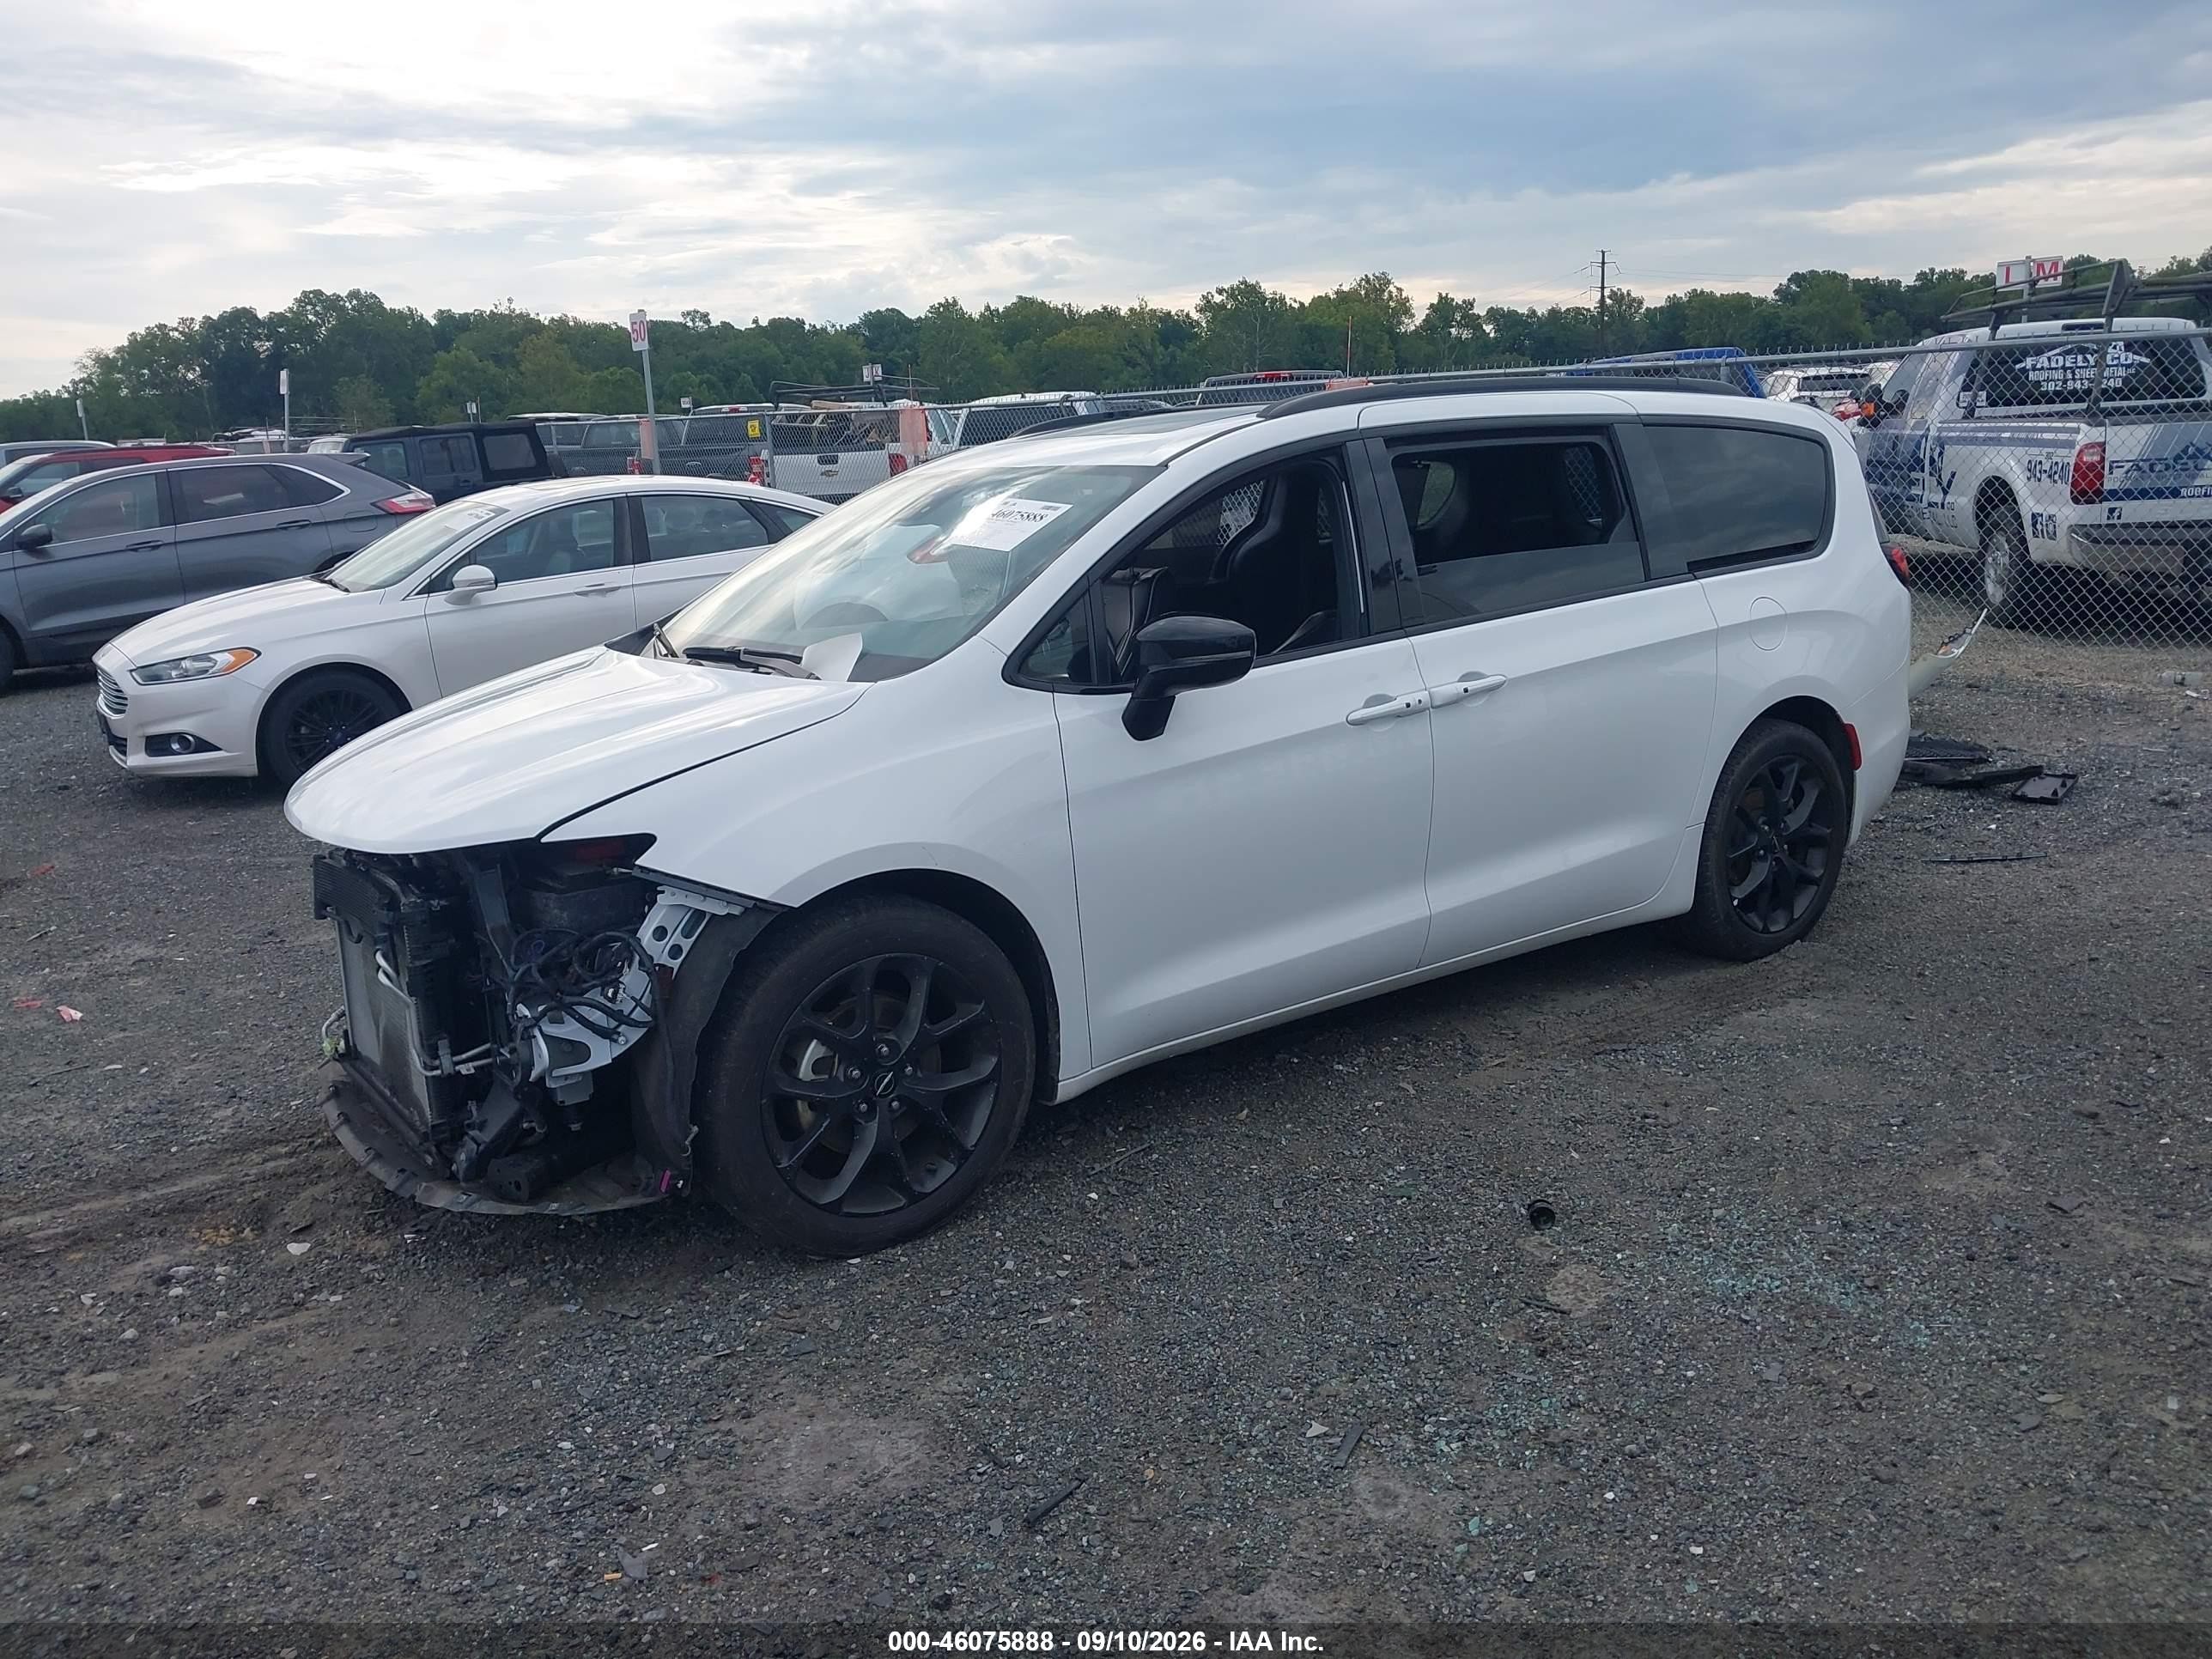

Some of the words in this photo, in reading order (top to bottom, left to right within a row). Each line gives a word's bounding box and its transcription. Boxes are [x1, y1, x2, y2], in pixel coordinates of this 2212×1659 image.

[2036, 261, 2059, 282] M
[631, 320, 646, 343] 50
[2026, 354, 2098, 369] FADELY
[2028, 369, 2063, 381] ROOFING
[2066, 369, 2072, 379] &
[2040, 378, 2123, 392] 302-943-240
[2027, 459, 2070, 485] 943-4240
